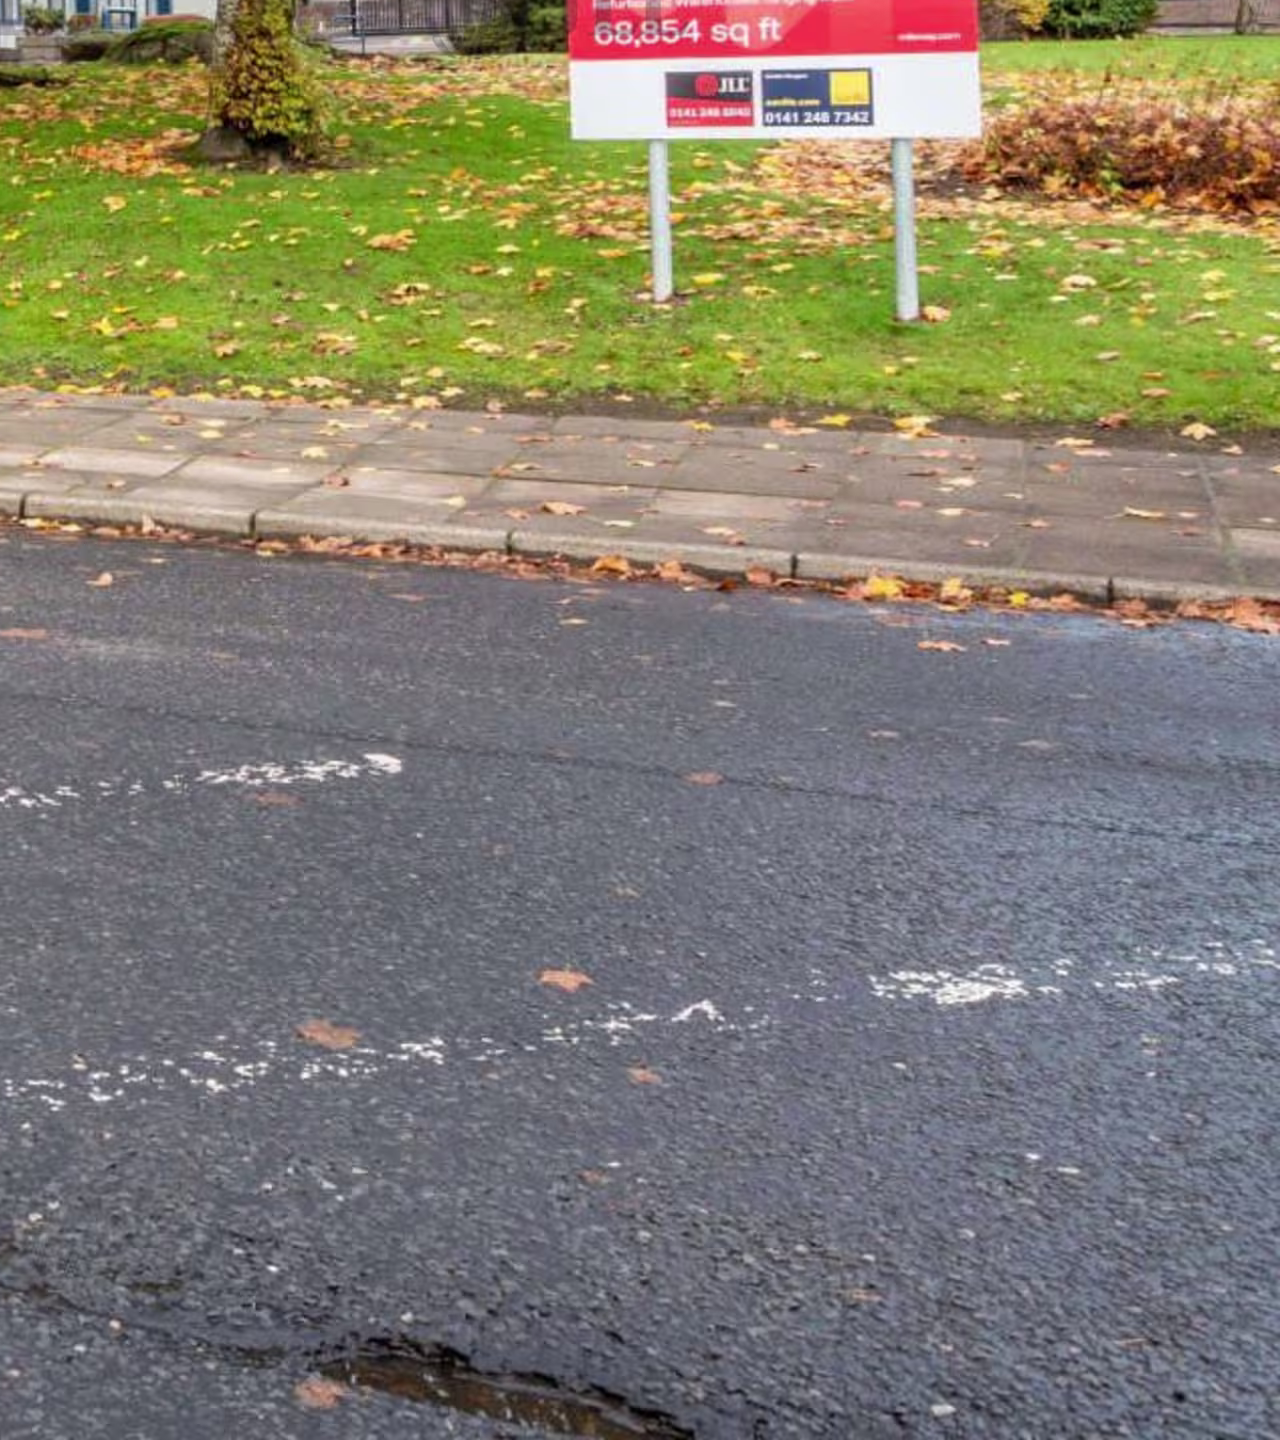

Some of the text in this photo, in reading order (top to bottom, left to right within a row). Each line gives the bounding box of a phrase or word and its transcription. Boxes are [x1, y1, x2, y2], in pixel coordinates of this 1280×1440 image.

[594, 16, 782, 48] 68,854 sq ft
[718, 77, 750, 92] JLL
[765, 112, 799, 123] 0141
[833, 111, 871, 123] 7342
